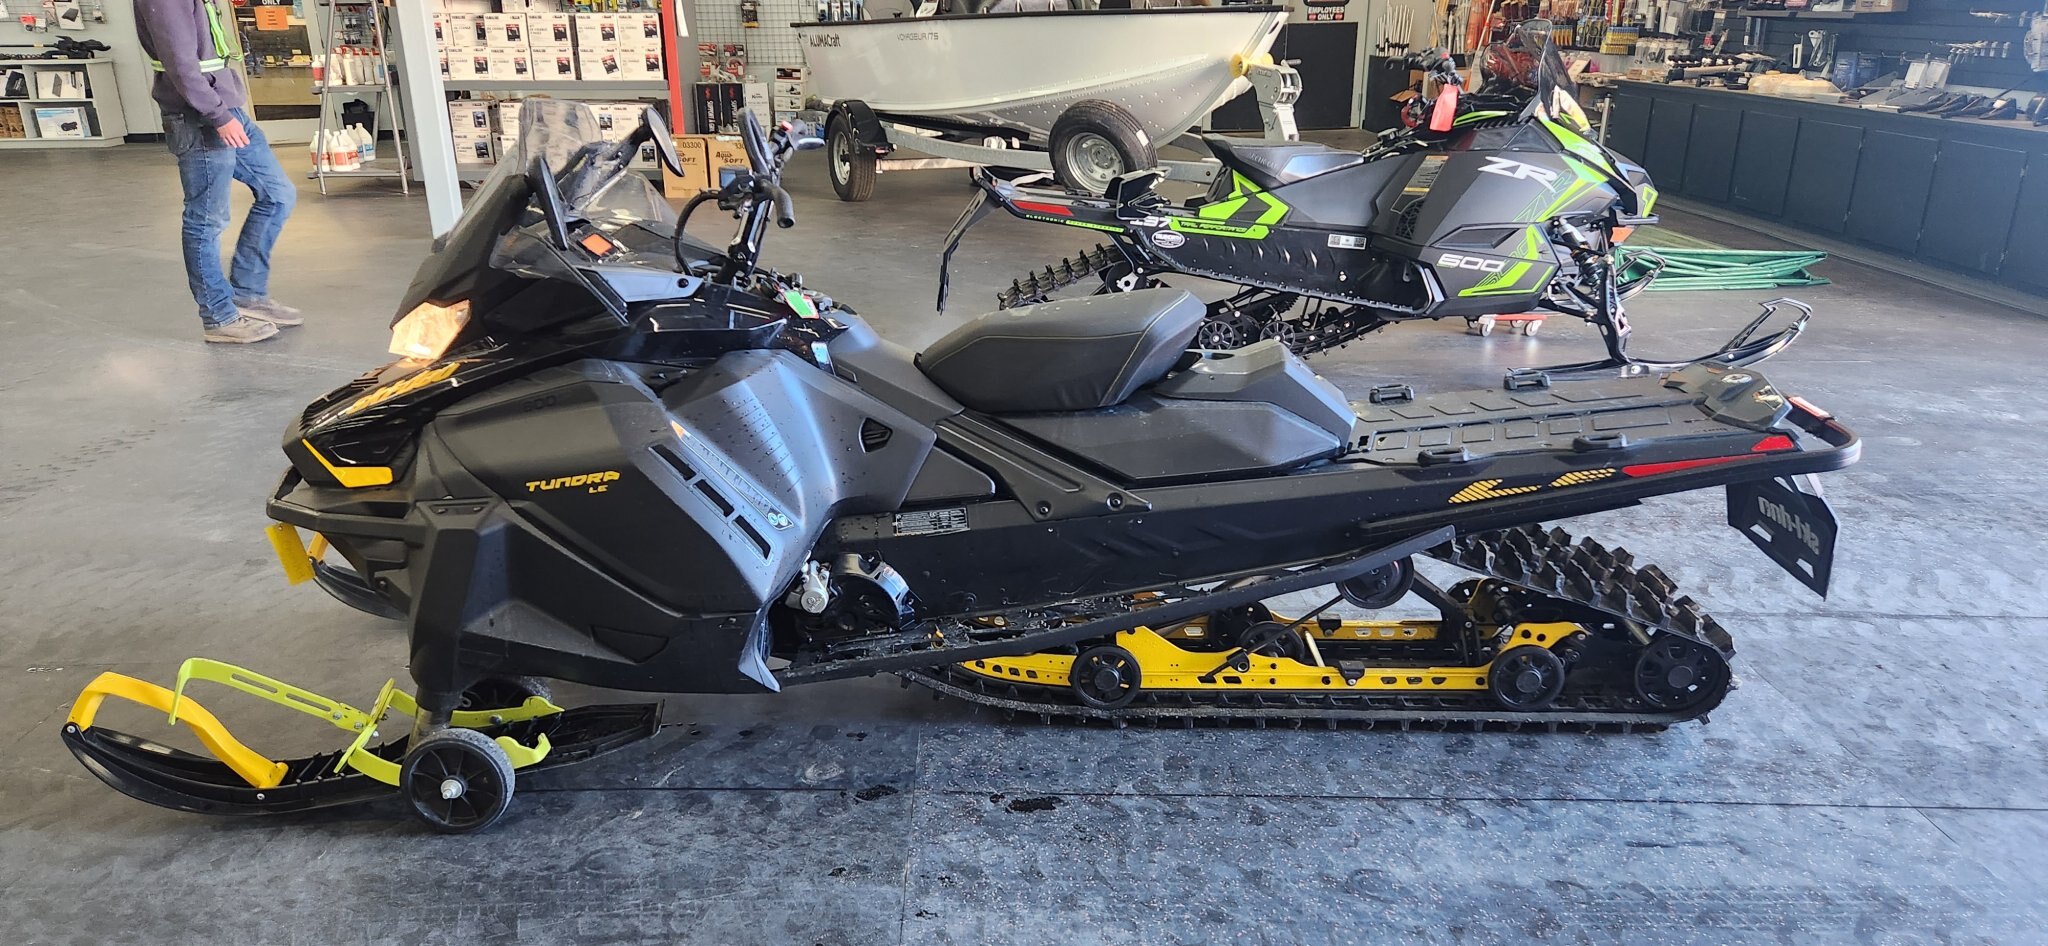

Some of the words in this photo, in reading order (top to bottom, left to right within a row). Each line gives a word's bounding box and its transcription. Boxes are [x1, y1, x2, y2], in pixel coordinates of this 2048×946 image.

[1308, 6, 1345, 14] EMPLOYEES
[682, 141, 702, 149] 03300
[1478, 156, 1557, 193] ZR
[1436, 253, 1505, 272] 600
[525, 470, 621, 492] TUNDRA
[588, 484, 609, 494] LE
